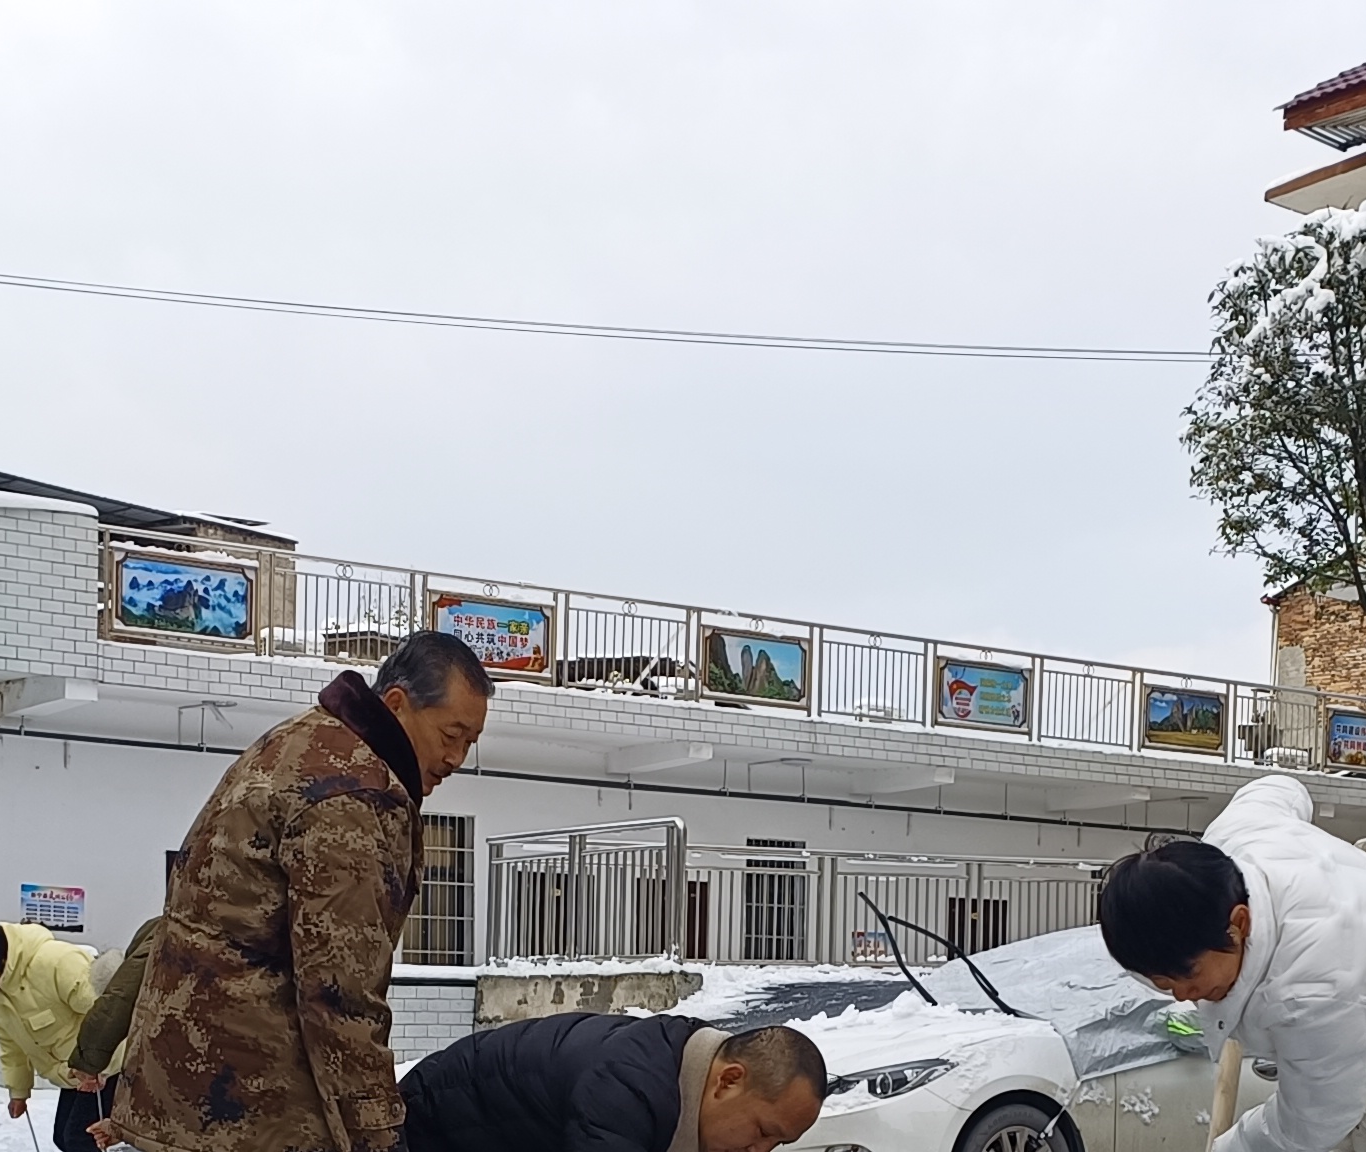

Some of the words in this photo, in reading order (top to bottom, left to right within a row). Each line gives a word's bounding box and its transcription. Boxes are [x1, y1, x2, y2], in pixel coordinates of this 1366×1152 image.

[453, 614, 530, 636] 中华民族一家亲
[453, 629, 529, 649] 同心共筑中国梦
